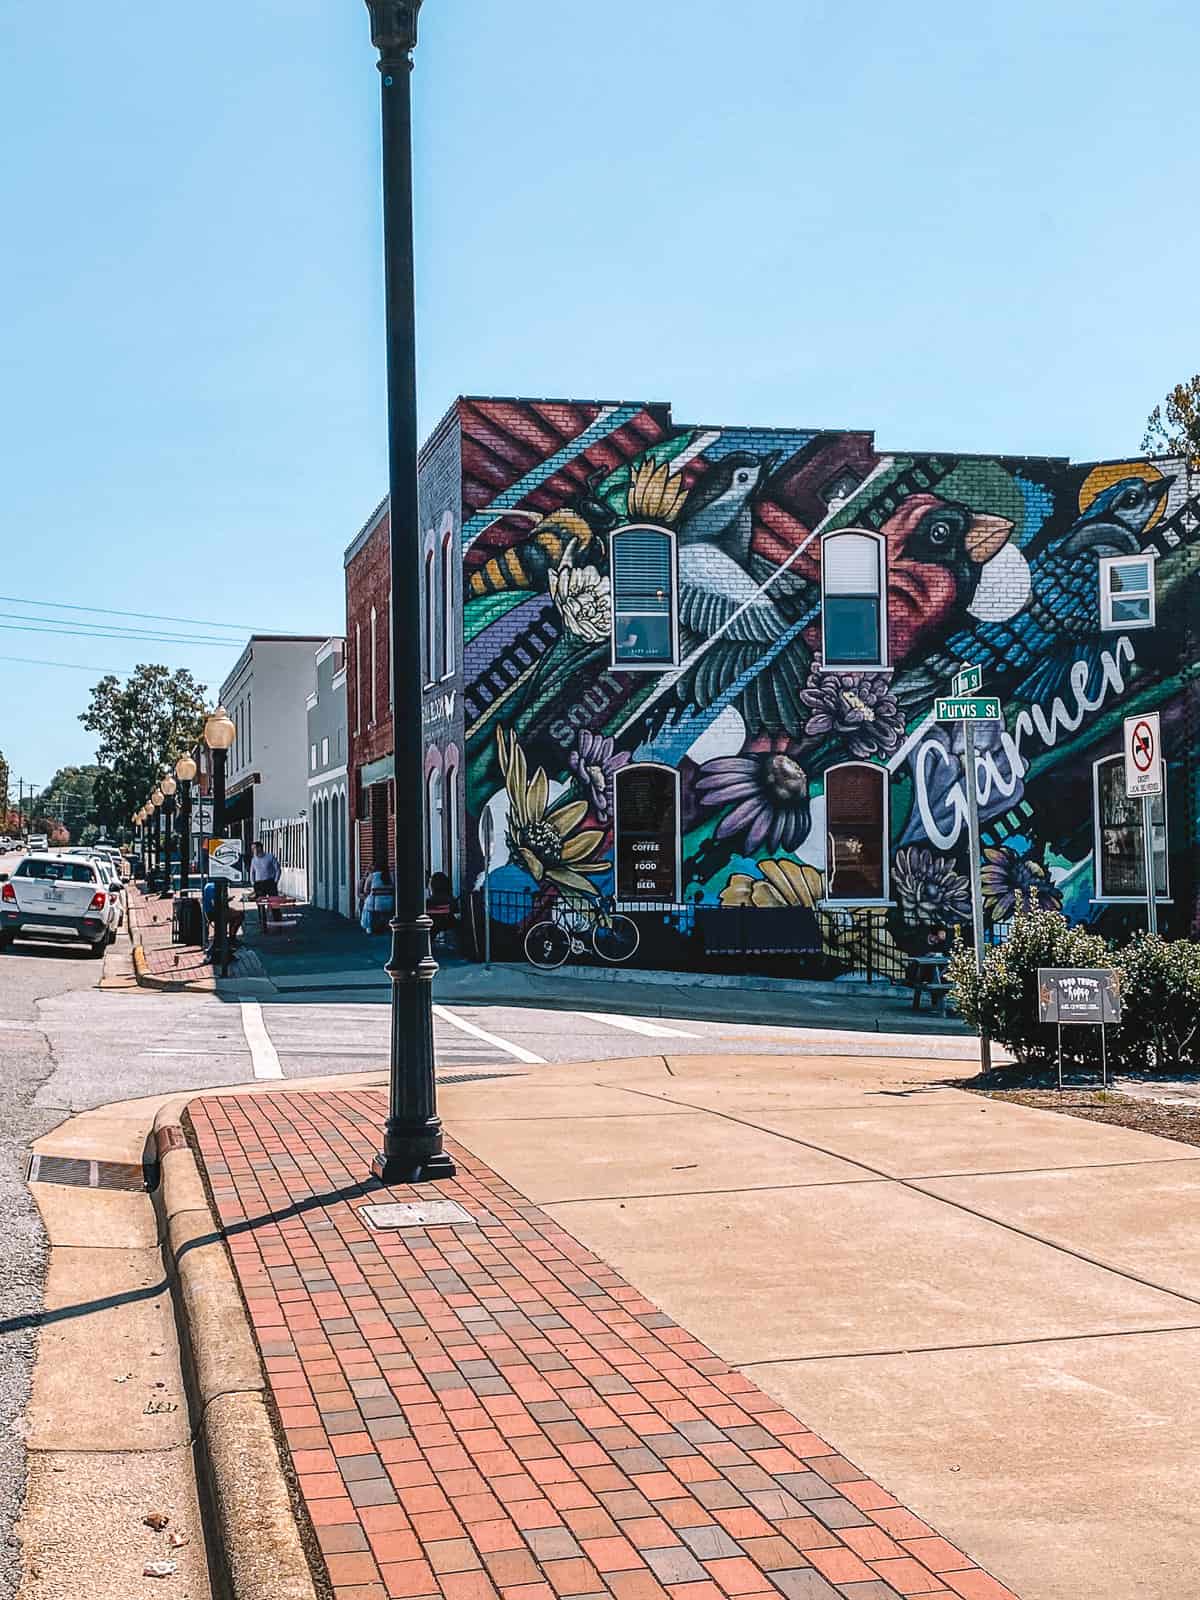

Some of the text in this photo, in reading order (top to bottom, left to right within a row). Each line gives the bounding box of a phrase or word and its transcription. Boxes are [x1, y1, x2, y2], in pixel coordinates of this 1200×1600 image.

[939, 702, 996, 718] Purvis St
[916, 636, 1135, 850] Garner
[632, 843, 660, 851] COFFEE
